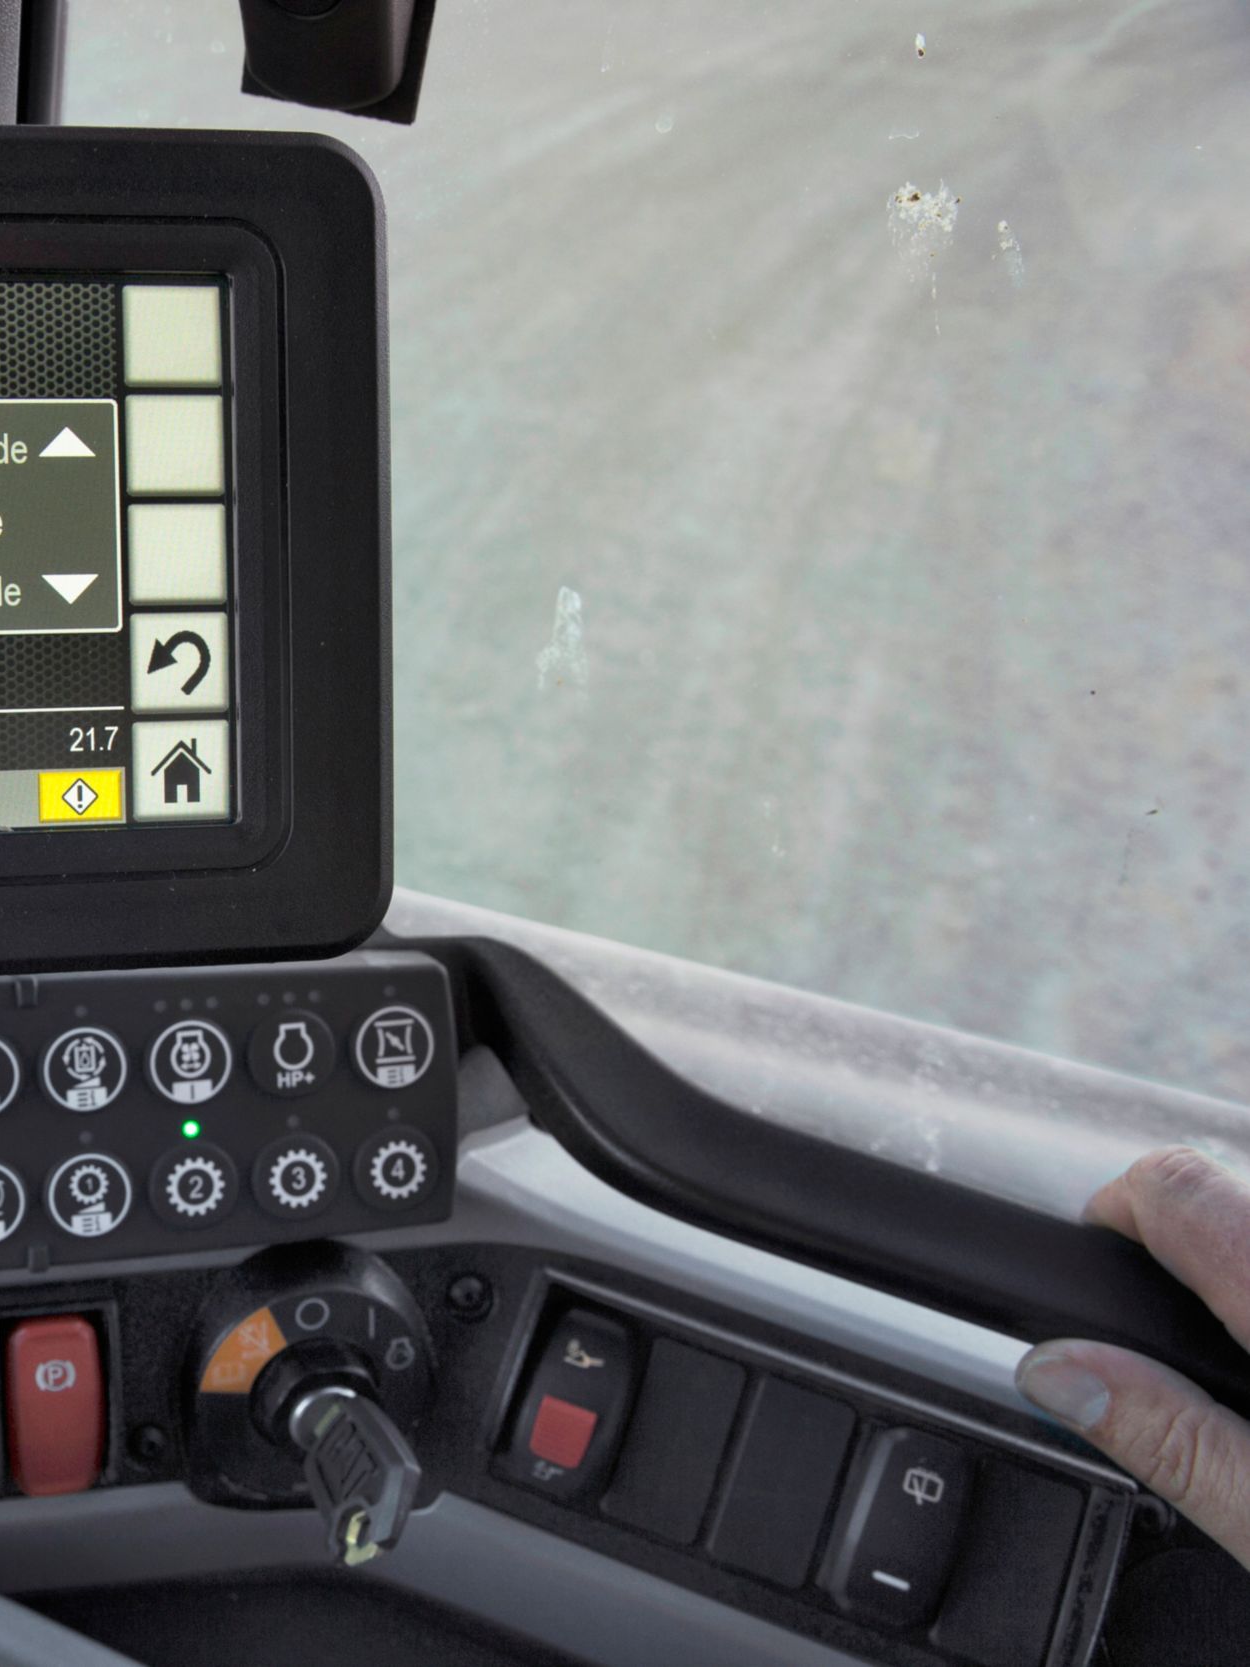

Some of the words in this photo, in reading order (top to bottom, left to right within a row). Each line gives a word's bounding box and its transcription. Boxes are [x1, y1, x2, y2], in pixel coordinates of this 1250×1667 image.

[69, 725, 119, 752] 21.7
[291, 1166, 307, 1190] 3
[390, 1157, 406, 1181] 4
[188, 1175, 204, 1199] 2
